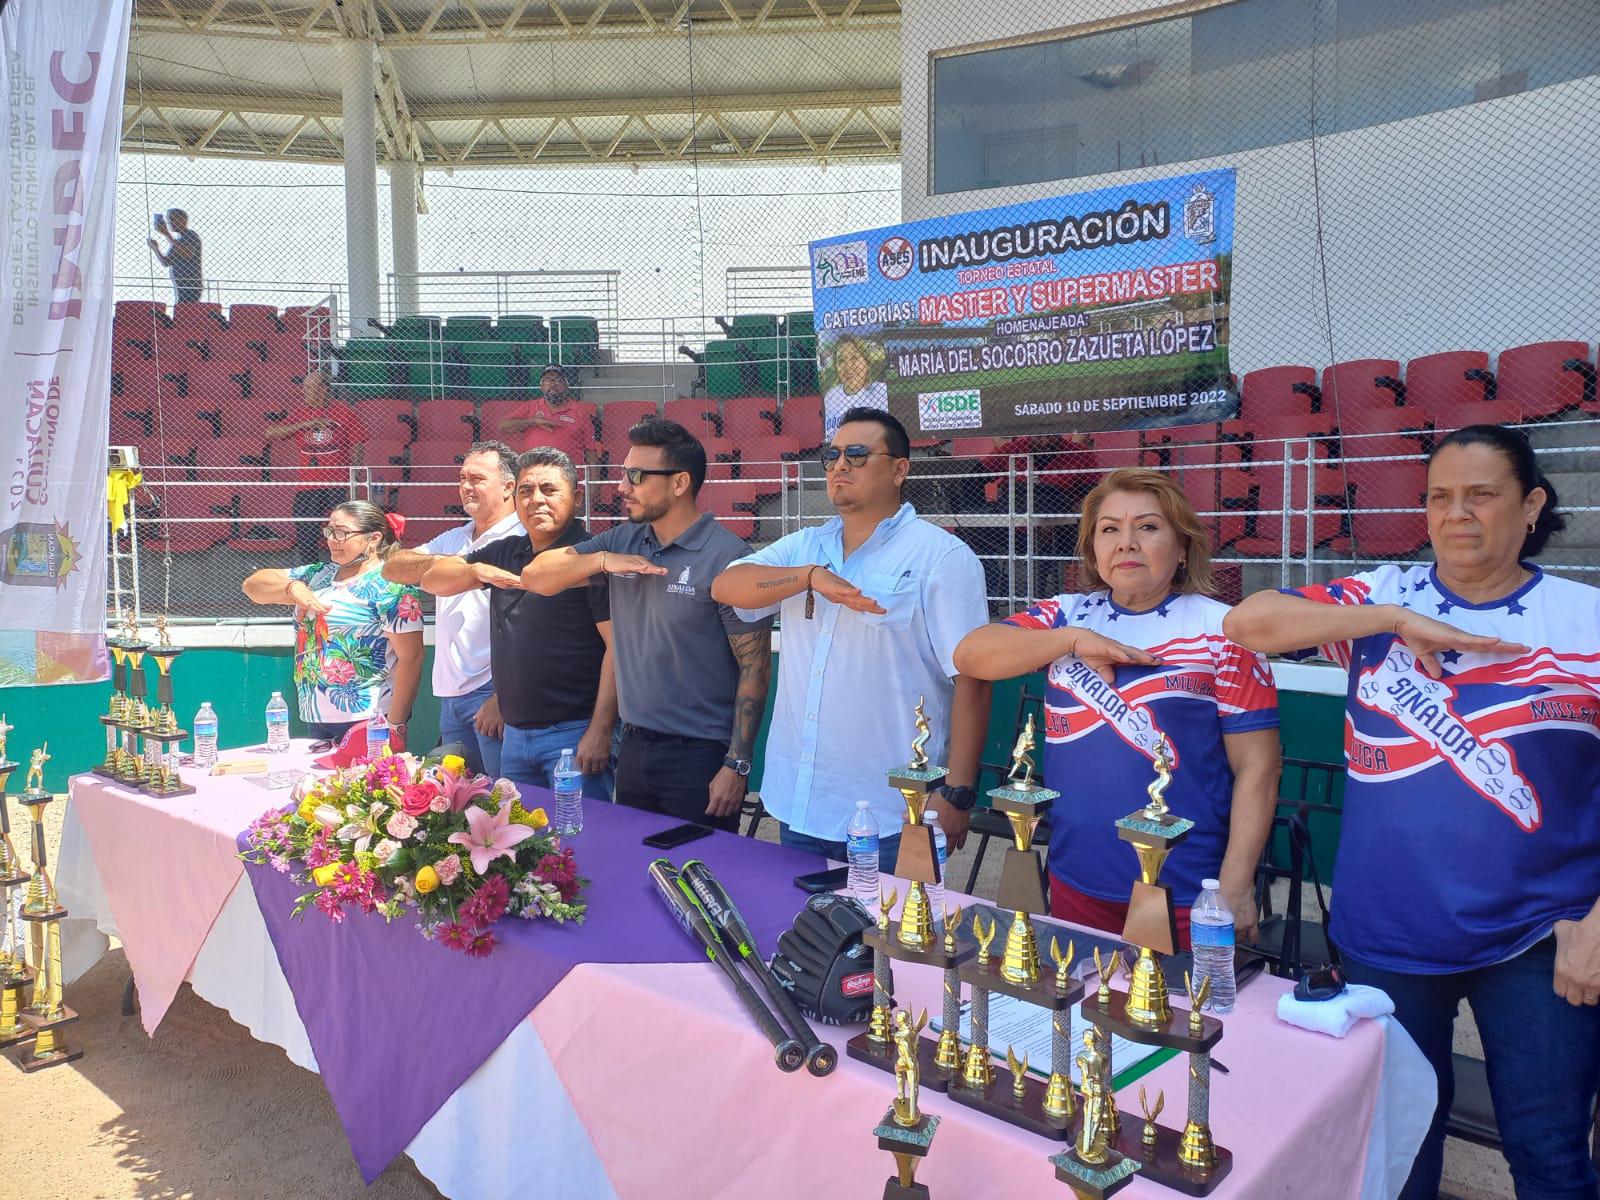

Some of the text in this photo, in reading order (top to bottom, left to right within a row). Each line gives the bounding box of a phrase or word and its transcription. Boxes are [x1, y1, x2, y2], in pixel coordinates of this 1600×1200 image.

[920, 202, 1168, 270] INAUGURACIÓN
[882, 249, 910, 268] ASES
[957, 259, 1058, 285] TORNEO ESTATAL
[822, 262, 1219, 330] CATEGORÍAS: MASTER Y SUPERMASTER
[996, 314, 1089, 336] HOMENAJEADA:
[898, 322, 1215, 377] MARÍA DEL SOCORRO ZAZUETA LÓPEZ
[939, 394, 979, 413] ISDE
[1014, 390, 1227, 416] SÁBADO 10 DE SEPTIEMBRE 2022
[1065, 661, 1128, 724] SINALOA
[1386, 677, 1477, 763] SINALOA
[1350, 741, 1390, 772] LIGA
[691, 877, 722, 917] EASTON
